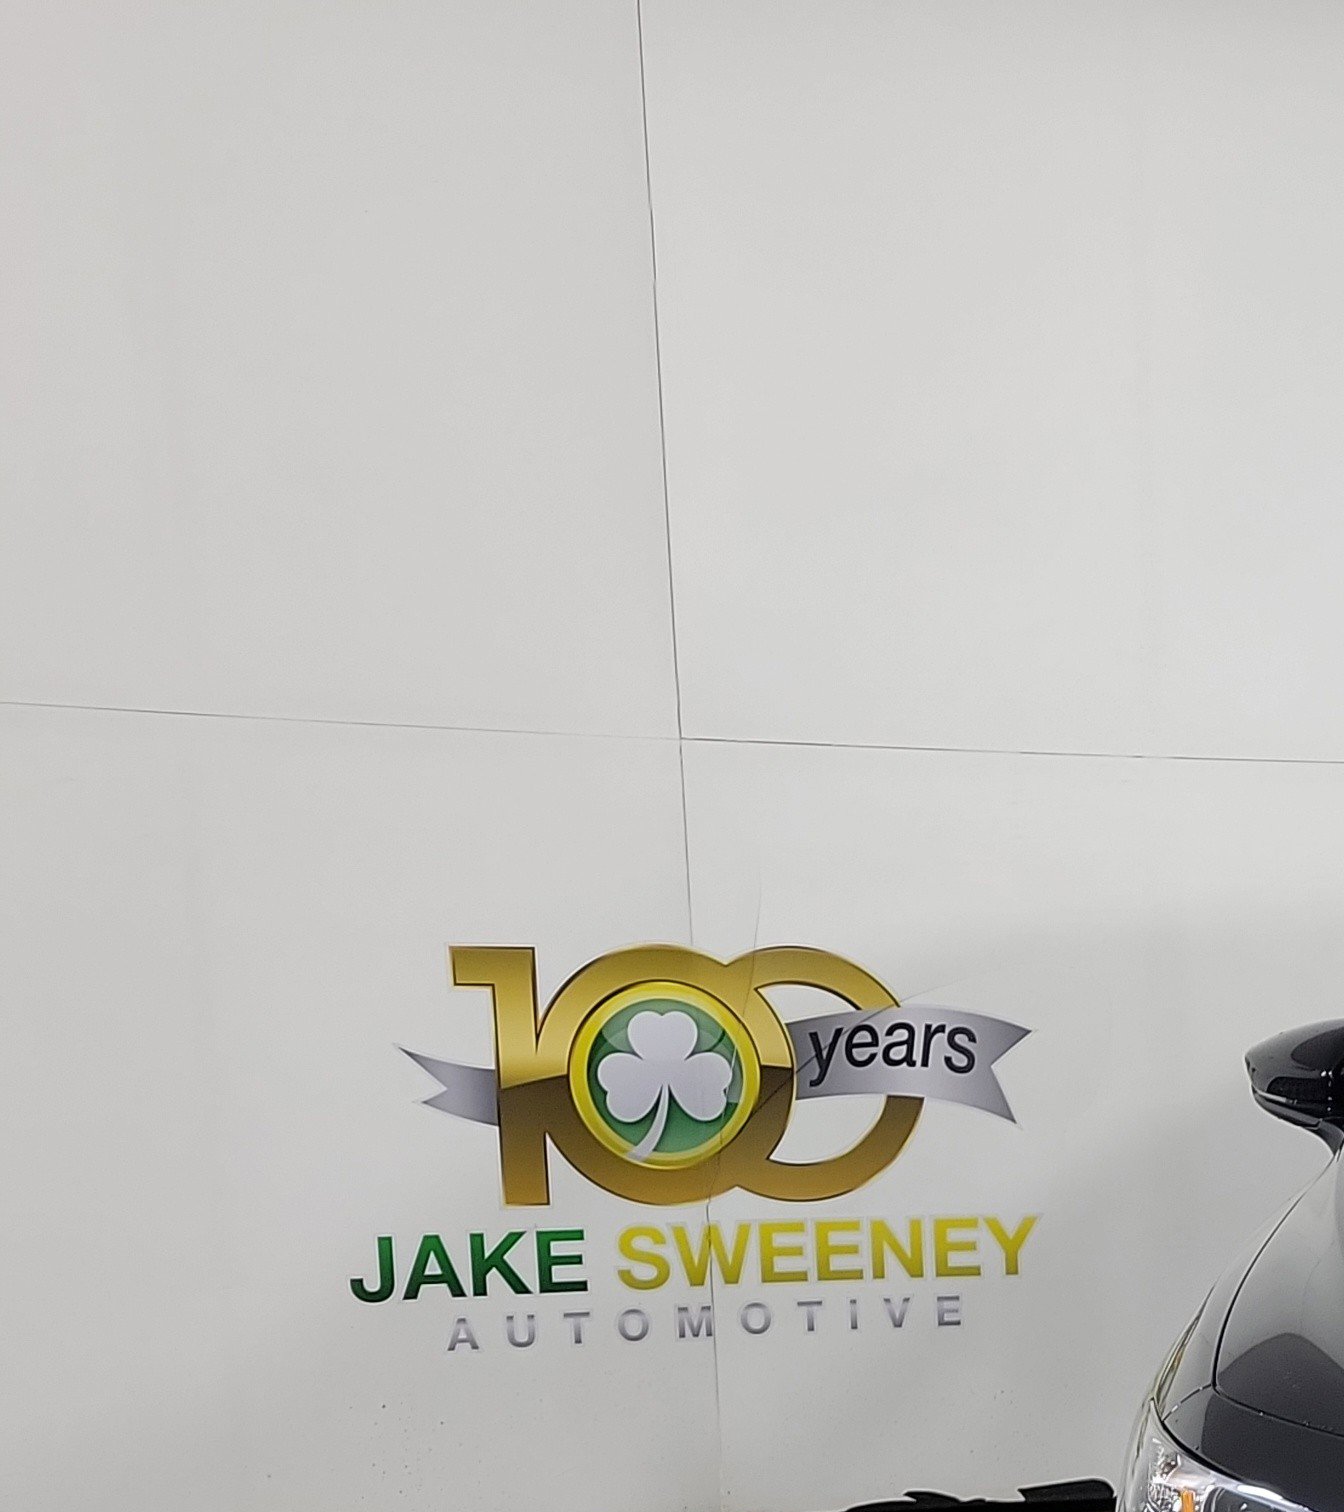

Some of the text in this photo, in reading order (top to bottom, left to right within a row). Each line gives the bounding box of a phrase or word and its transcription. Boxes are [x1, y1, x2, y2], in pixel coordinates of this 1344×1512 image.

[449, 944, 978, 1206] 100 years
[350, 1215, 1039, 1303] JAKE SWEENEY
[447, 1296, 961, 1351] AUTOMOTIVE
